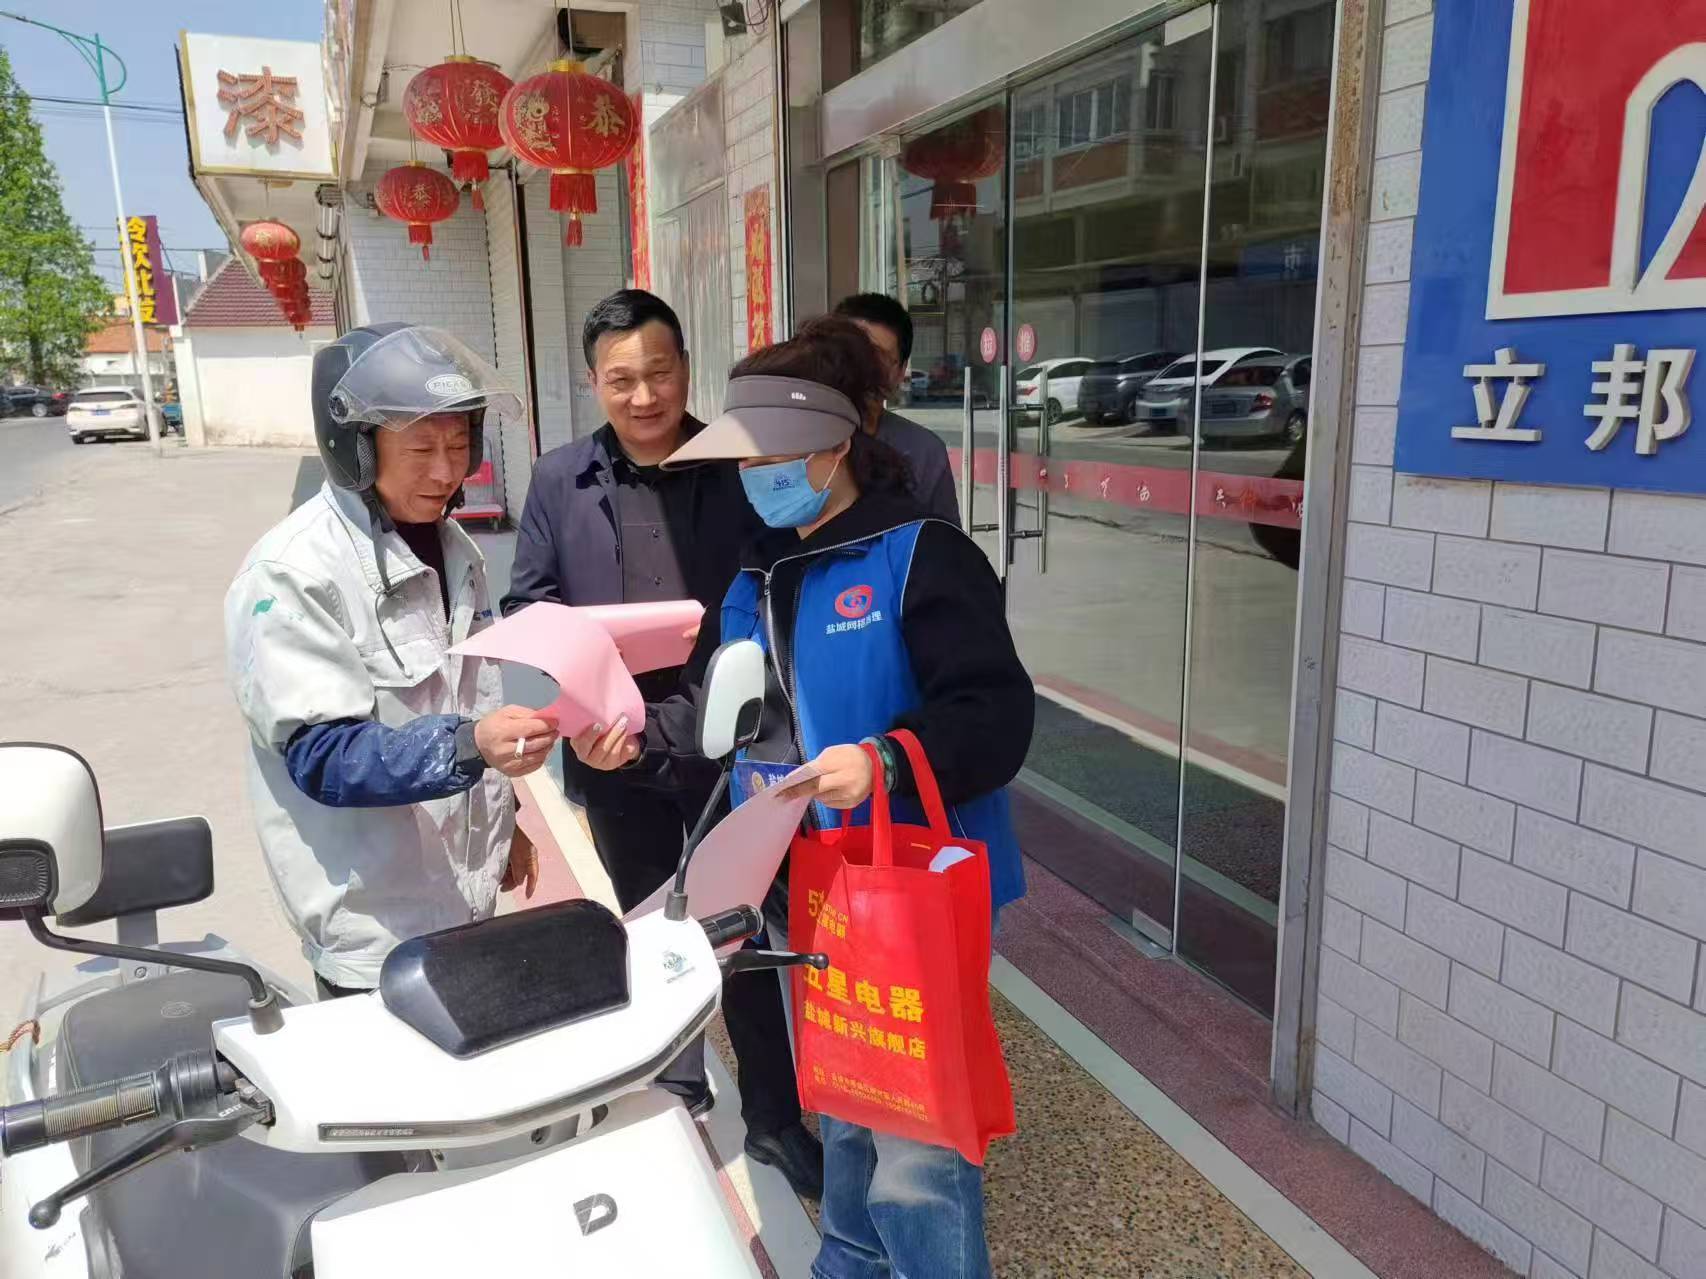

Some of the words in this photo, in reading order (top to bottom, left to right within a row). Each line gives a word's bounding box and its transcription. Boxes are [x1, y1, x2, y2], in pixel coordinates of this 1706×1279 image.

[216, 66, 305, 145] 漆
[1451, 343, 1696, 455] 立邦
[804, 1000, 926, 1060] 盐城新兴旗舰店
